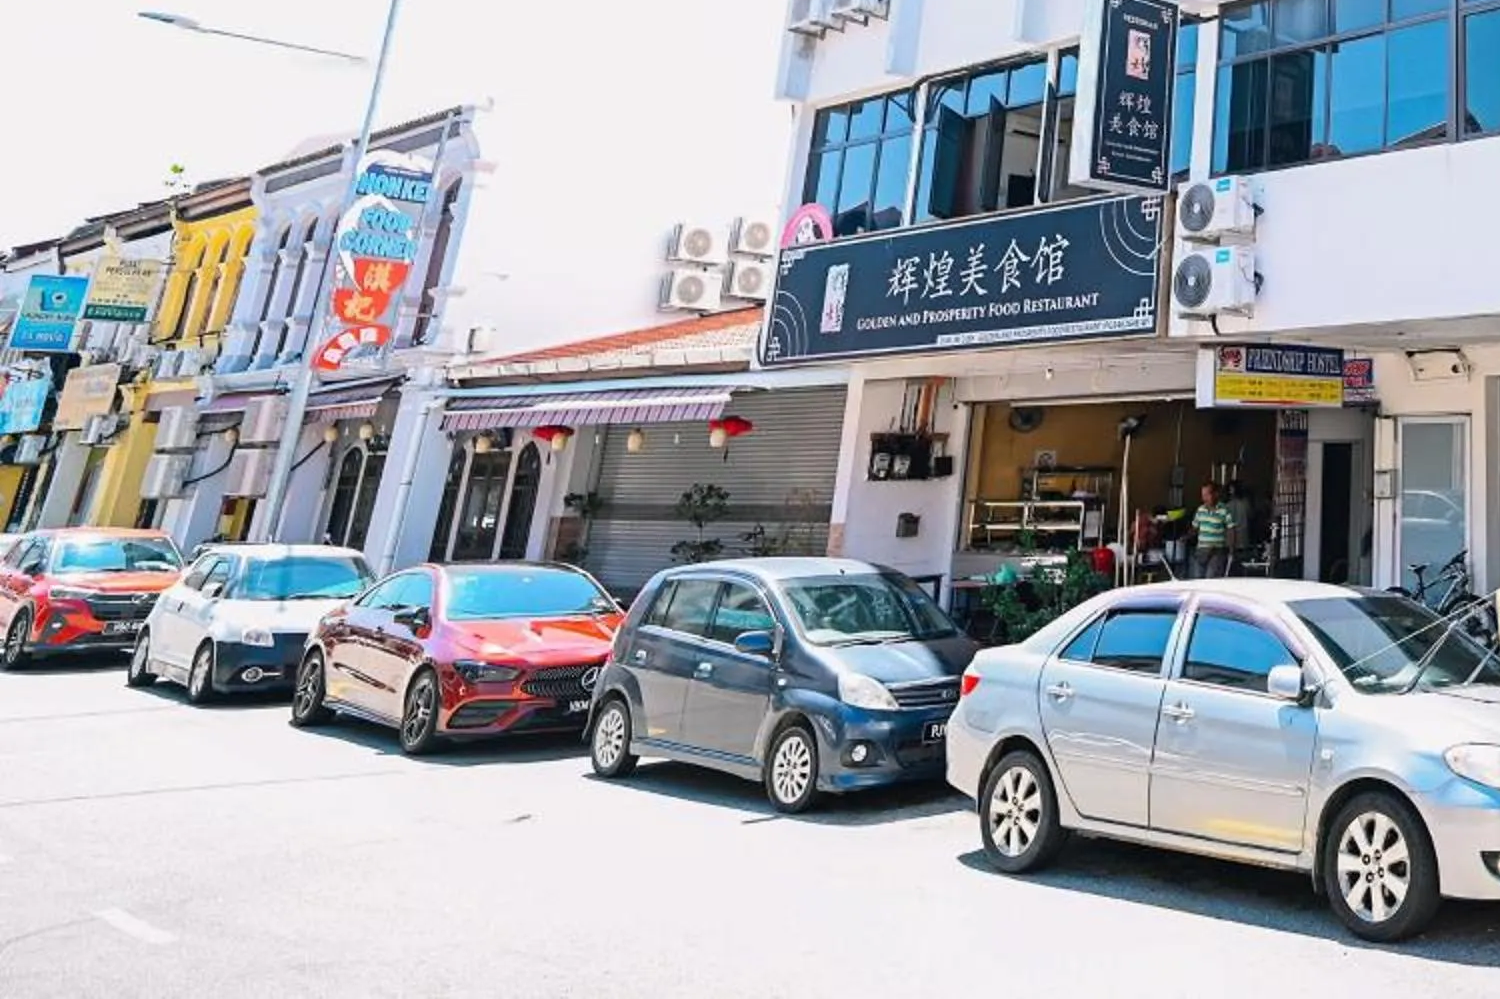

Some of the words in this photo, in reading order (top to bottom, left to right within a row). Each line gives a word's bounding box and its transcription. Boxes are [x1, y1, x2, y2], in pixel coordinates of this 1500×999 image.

[886, 233, 1072, 306] 辉煌美食馆
[856, 313, 898, 331] GOLDEN
[899, 311, 921, 327] AND
[923, 304, 987, 325] PROSPERITY
[988, 300, 1021, 318] FOOD
[1022, 291, 1101, 314] RESTAURANT
